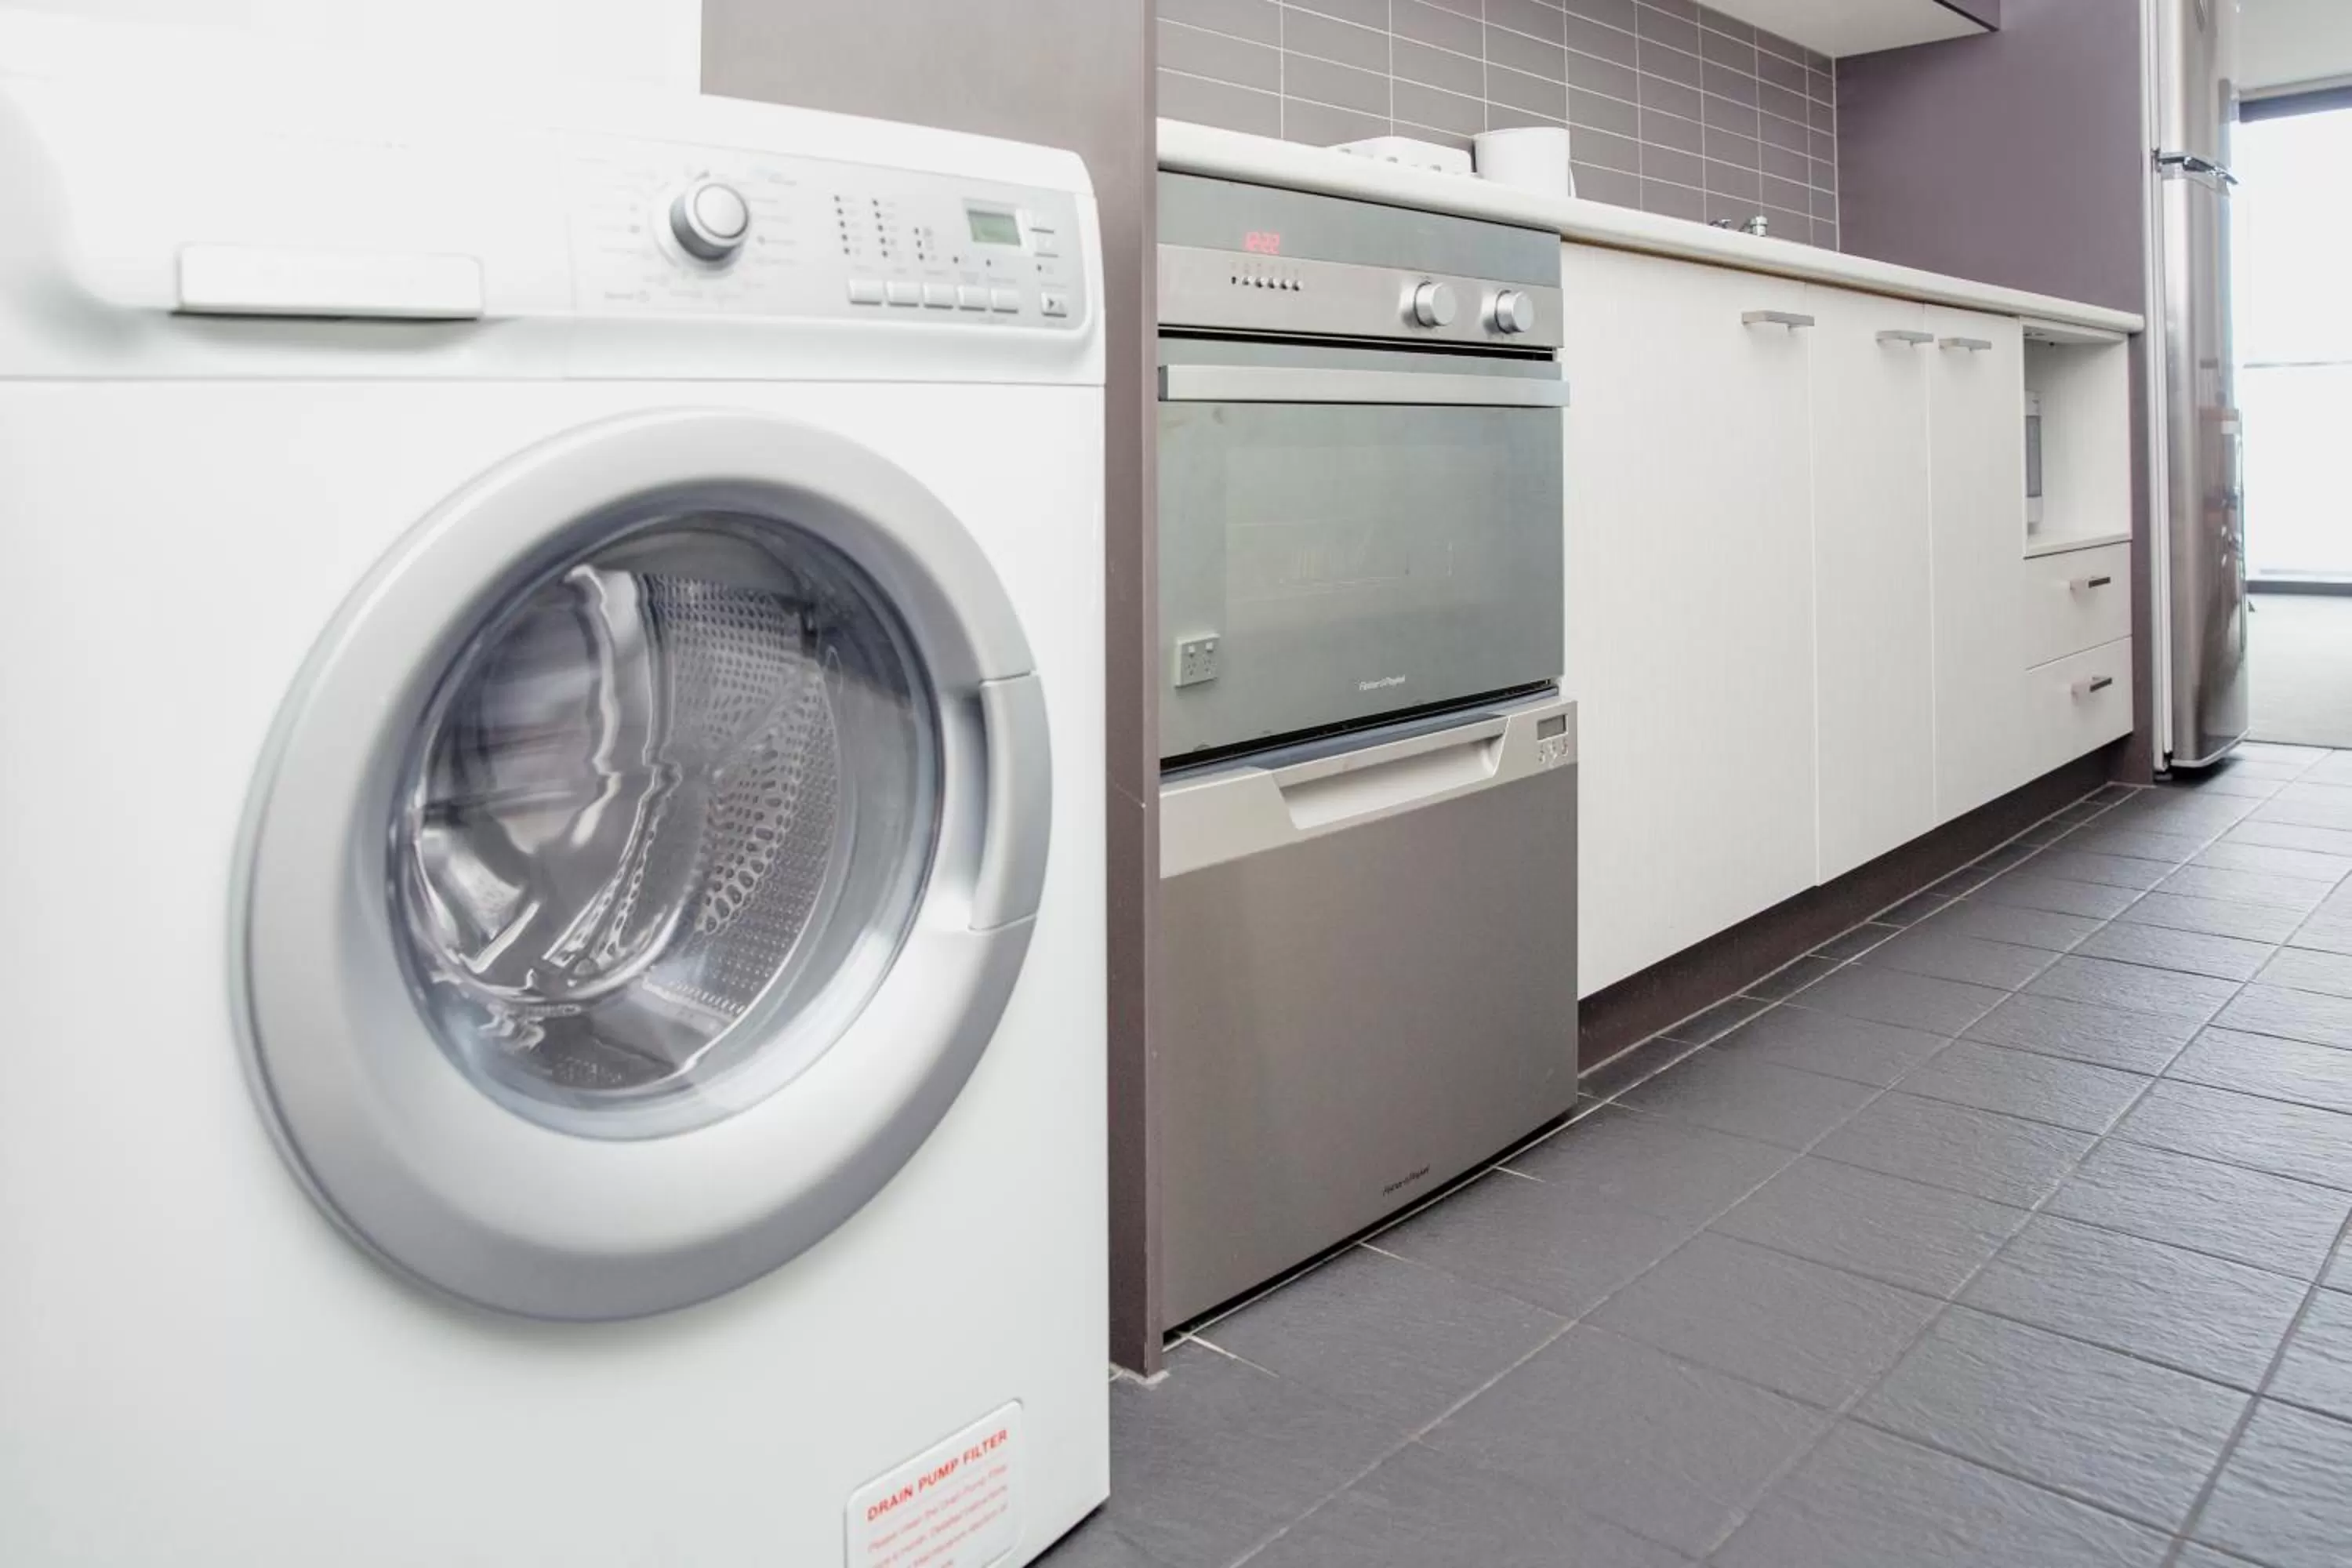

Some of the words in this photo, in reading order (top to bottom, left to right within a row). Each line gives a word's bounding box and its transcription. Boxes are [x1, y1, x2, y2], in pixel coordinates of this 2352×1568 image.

[867, 1485, 913, 1521] DRAIN
[918, 1457, 960, 1493] PUMP
[963, 1429, 1007, 1465] FILTER
